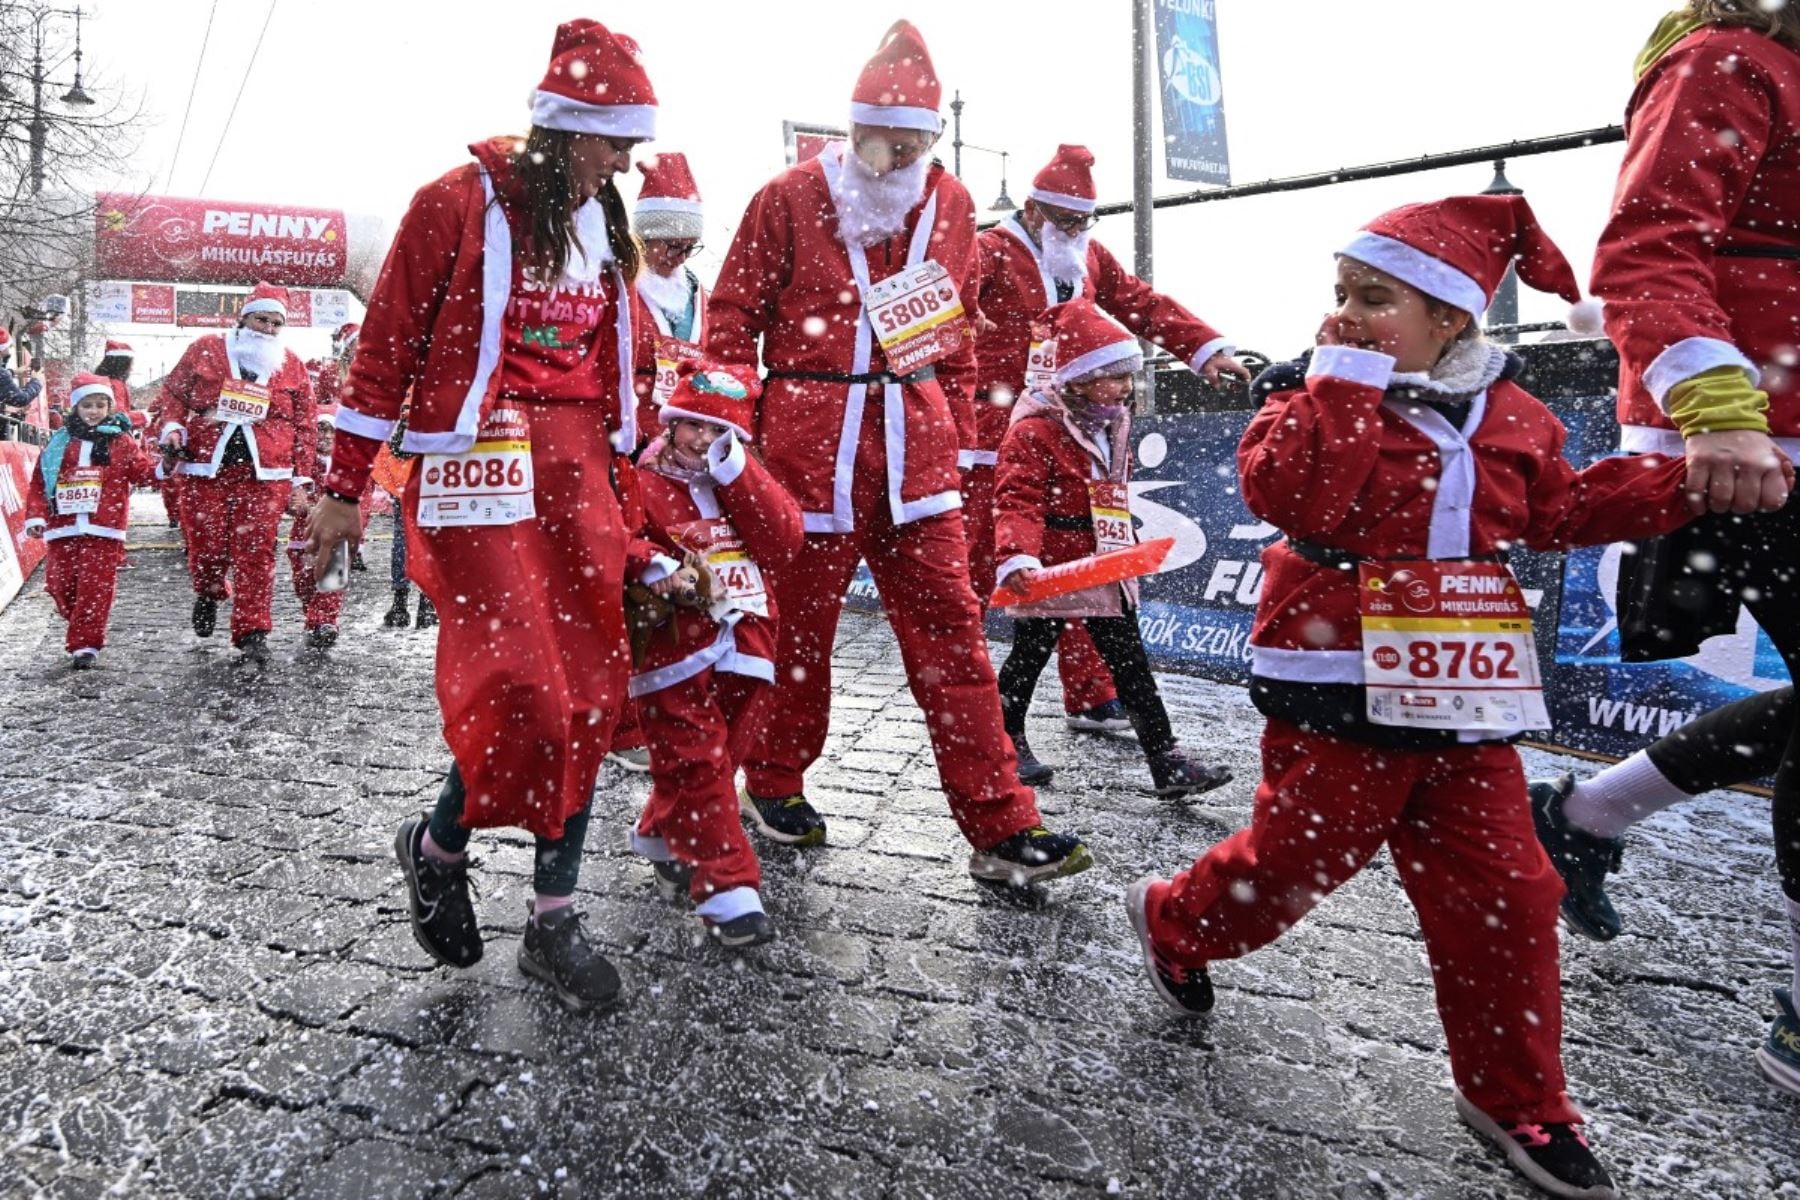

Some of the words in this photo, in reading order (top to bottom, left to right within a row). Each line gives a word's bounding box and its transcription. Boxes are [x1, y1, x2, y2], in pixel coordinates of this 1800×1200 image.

[202, 245, 336, 267] MIKULÁSFUTÁS
[878, 290, 941, 333] 8085
[229, 399, 264, 416] 8020
[442, 458, 524, 489] 8086
[65, 487, 98, 500] 8614
[1440, 598, 1519, 613] MIKULÁSFUTÁS
[1375, 652, 1398, 664] 11:00
[1407, 640, 1520, 681] 8762
